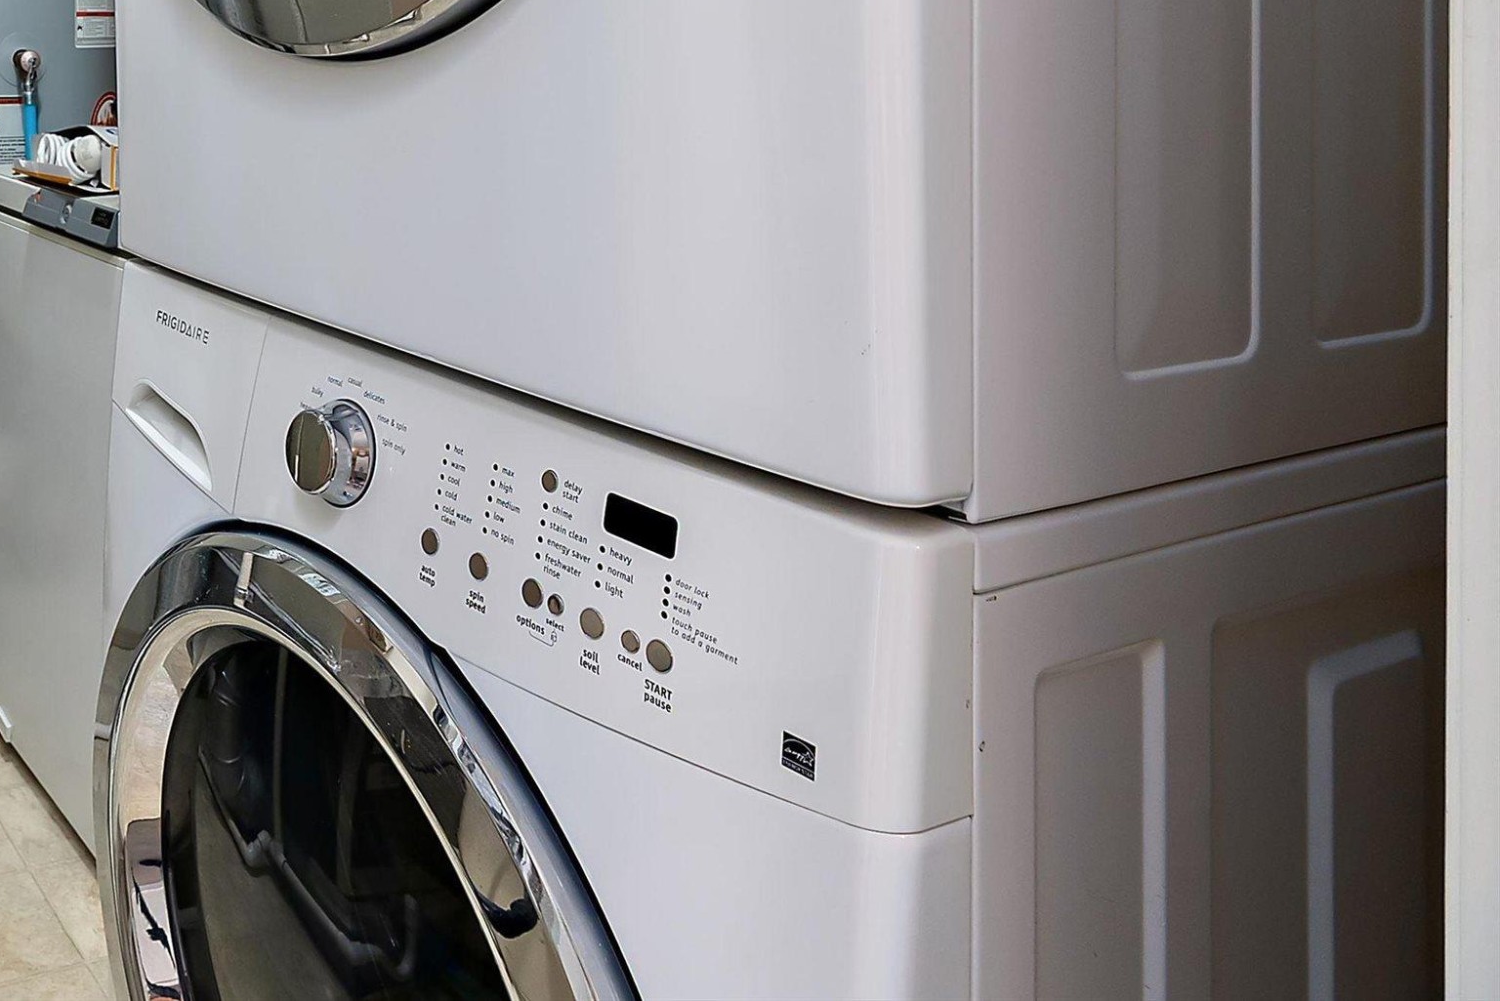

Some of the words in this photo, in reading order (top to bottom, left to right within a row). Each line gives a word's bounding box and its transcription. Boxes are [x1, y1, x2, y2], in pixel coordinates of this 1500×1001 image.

[156, 309, 210, 345] FRIGIDAIRE
[363, 390, 386, 405] delicates
[376, 414, 390, 424] rinse
[396, 421, 408, 433] spin
[381, 437, 393, 448] spin
[394, 443, 406, 456] only
[453, 444, 464, 456] hot
[450, 461, 466, 473] warm
[501, 467, 515, 477] max
[447, 475, 461, 487] cool
[498, 480, 513, 494] high
[563, 479, 583, 496] delay
[444, 489, 458, 501] cold
[562, 490, 579, 503] start
[442, 504, 455, 516] cold
[455, 512, 473, 524] water
[496, 497, 521, 514] medium
[551, 505, 573, 520] chime
[440, 514, 457, 527] clean
[493, 511, 505, 523] low
[490, 528, 500, 538] no
[500, 533, 515, 546] spin
[549, 521, 567, 535] stain
[568, 529, 588, 545] clean
[546, 538, 571, 556] energy
[571, 549, 591, 564] saver
[609, 547, 633, 566] heavy
[420, 564, 436, 578] auto
[543, 565, 561, 580] rinse
[544, 552, 582, 578] freshwater
[419, 572, 436, 588] temp
[607, 566, 634, 584] normal
[468, 589, 485, 603] spin
[604, 581, 624, 599] light
[675, 578, 693, 592] door
[693, 585, 711, 599] lock
[465, 598, 487, 614] speed
[674, 591, 703, 610] sensing
[672, 602, 692, 617] wash
[516, 614, 545, 636] options
[545, 617, 565, 632] select
[671, 616, 693, 632] touch
[694, 627, 718, 645] pause
[671, 626, 679, 636] to
[681, 631, 696, 645] add
[705, 644, 739, 666] garment
[582, 649, 599, 664] soil
[617, 653, 643, 672] cancel
[579, 655, 600, 676] level
[644, 678, 673, 701] START
[643, 691, 672, 714] pause
